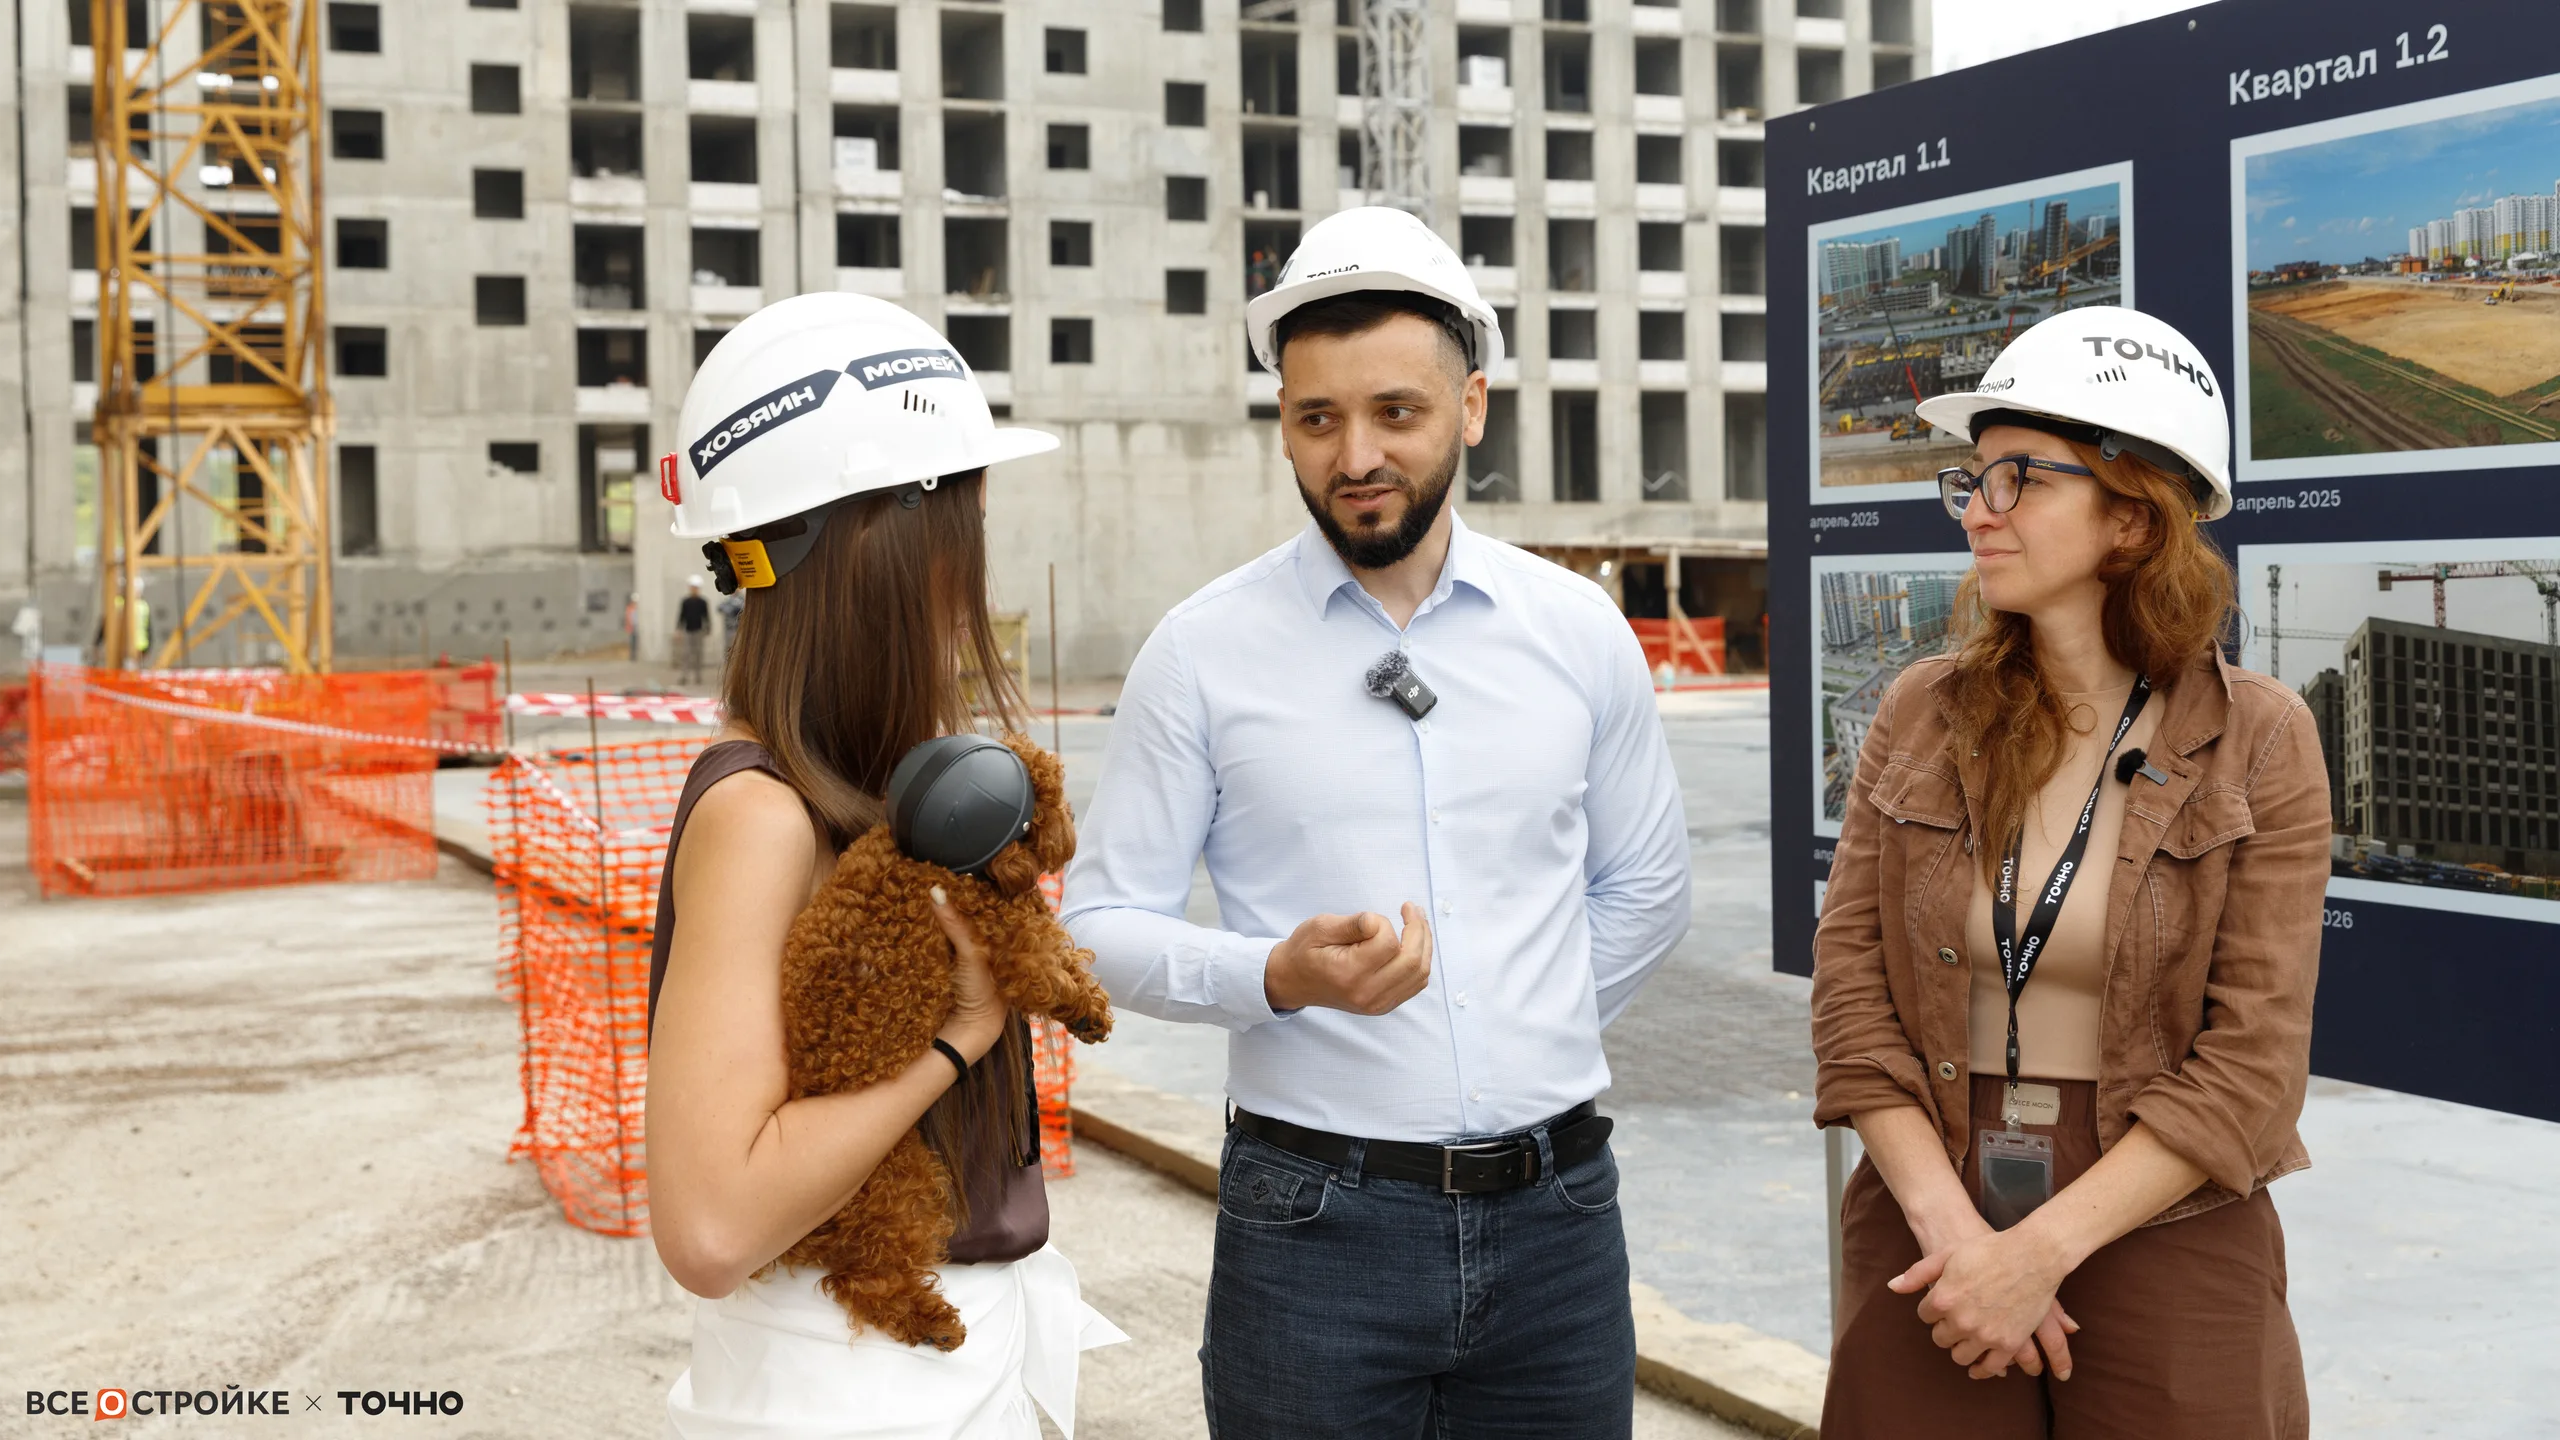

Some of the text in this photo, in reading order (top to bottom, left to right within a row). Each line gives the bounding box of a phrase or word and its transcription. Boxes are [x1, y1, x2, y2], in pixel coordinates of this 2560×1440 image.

[2229, 23, 2449, 106] Квартал 1.2
[1807, 137, 1951, 196] Квартал 1.1
[1978, 376, 2015, 393] ТОЧНО
[2082, 336, 2214, 398] ТОЧНО
[698, 355, 960, 467] ХОЗЯИН МОРЕЙ
[1809, 511, 1880, 531] апрель 2025
[2236, 489, 2341, 514] апрель 2025
[2109, 716, 2130, 752] ОЧНО
[2078, 787, 2099, 834] ТОЧНО
[1813, 848, 1834, 864] апр
[2000, 857, 2014, 903] ТОЧНО
[2045, 861, 2074, 905] ТОЧНО
[2321, 909, 2354, 929] 026
[2015, 935, 2041, 982] ТОЧНО
